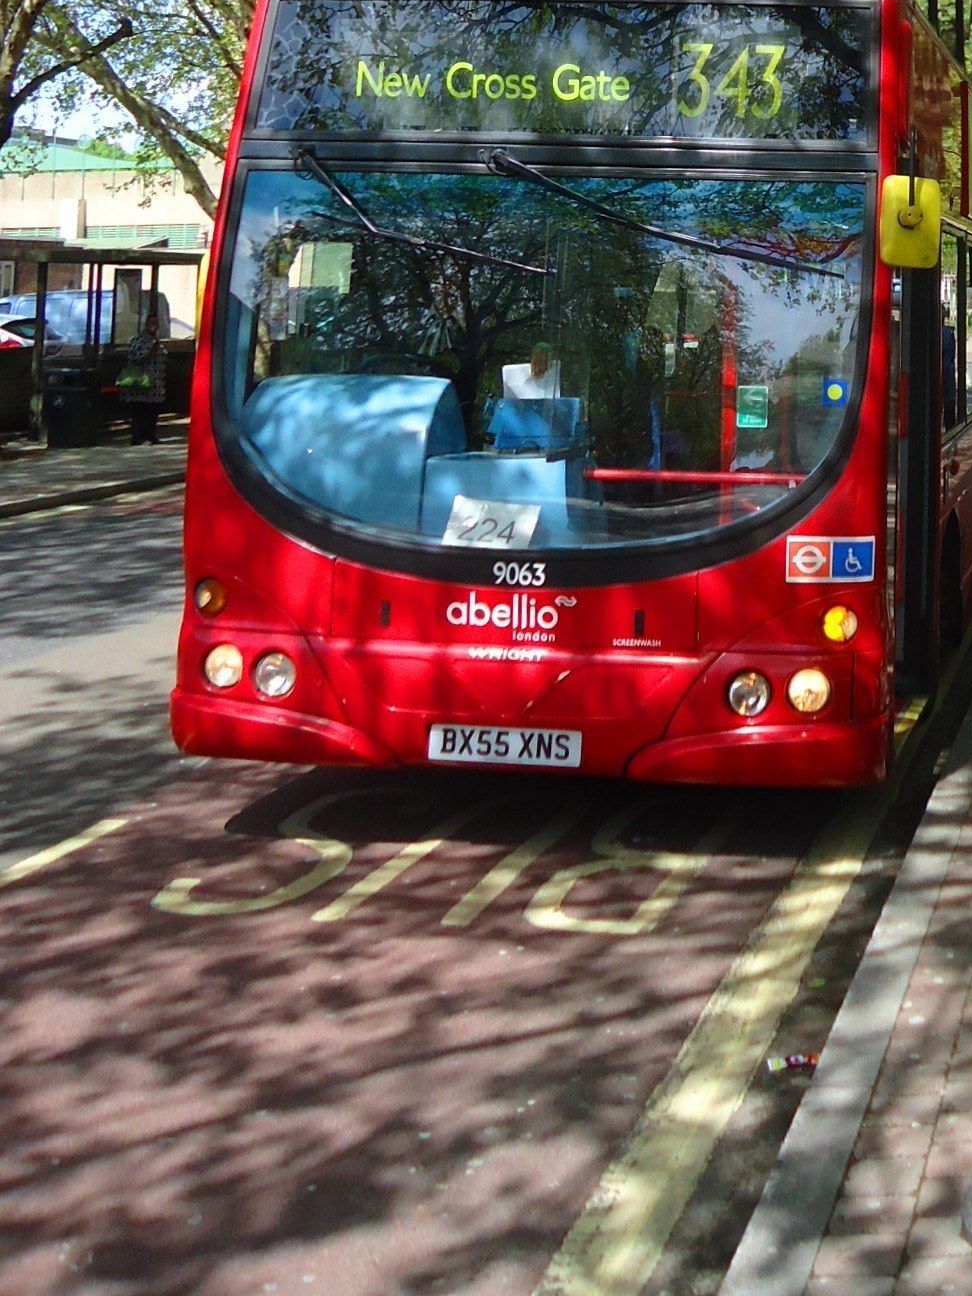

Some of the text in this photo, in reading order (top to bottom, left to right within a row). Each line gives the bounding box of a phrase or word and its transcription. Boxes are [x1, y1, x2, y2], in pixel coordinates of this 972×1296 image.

[355, 61, 630, 102] New Cross Gate
[677, 43, 786, 119] 343
[457, 518, 516, 544] 224
[493, 561, 546, 587] 9063
[446, 591, 559, 630] abellio
[512, 630, 556, 642] london
[612, 638, 661, 647] SCREENWASH
[468, 647, 545, 662] WRIGHT
[440, 727, 570, 760] BX55 XNS
